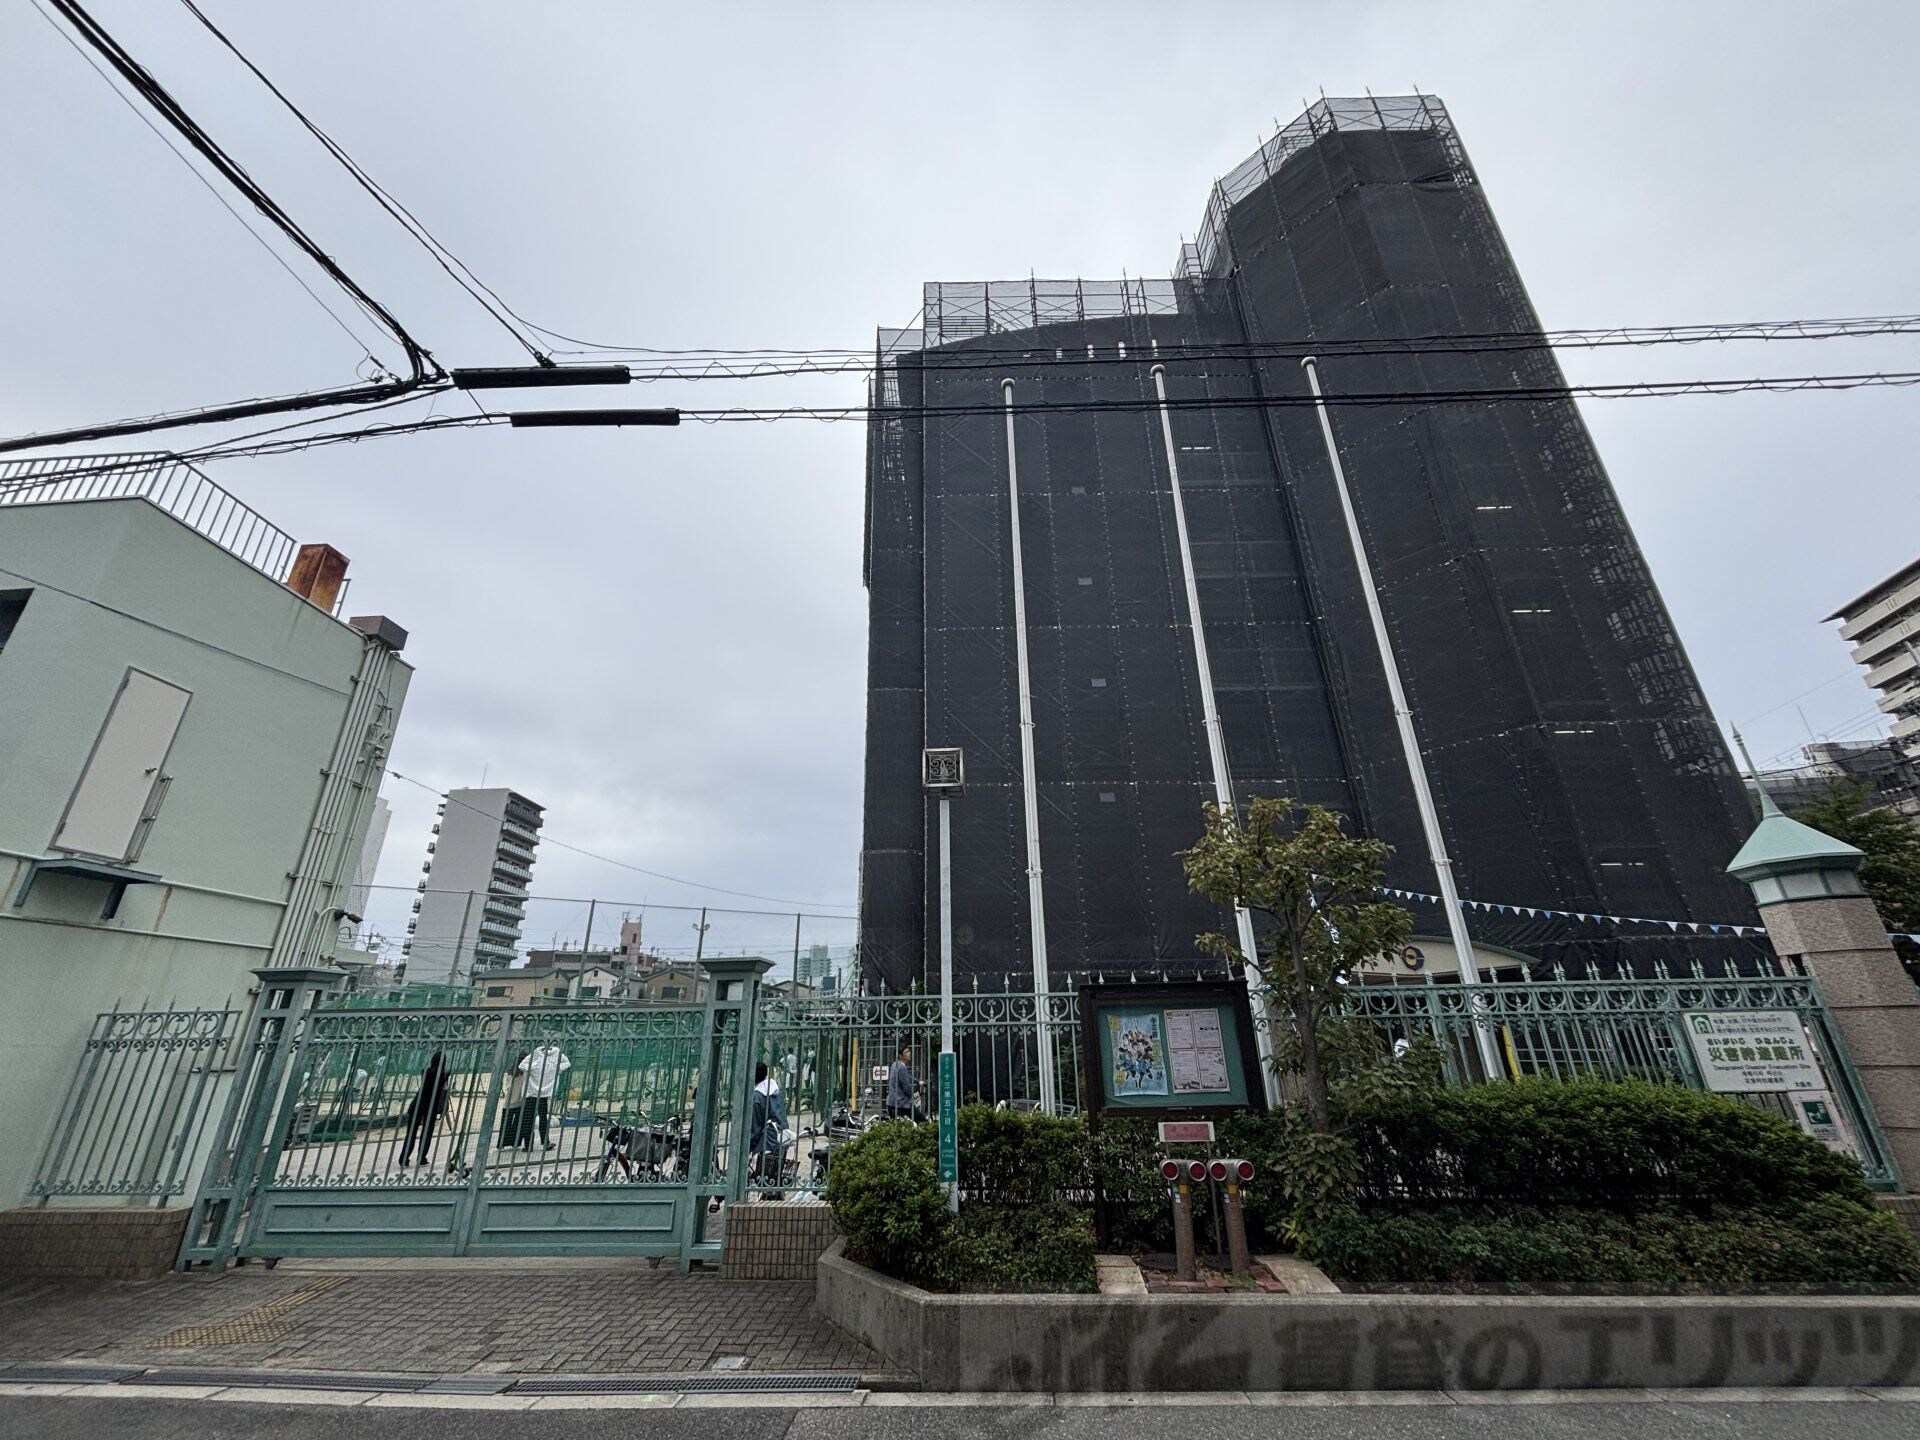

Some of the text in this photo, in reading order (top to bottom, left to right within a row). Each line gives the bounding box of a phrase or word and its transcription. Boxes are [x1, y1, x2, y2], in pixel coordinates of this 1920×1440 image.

[1708, 1046, 1804, 1061] 災害時避難所
[944, 1133, 951, 1144] 4
